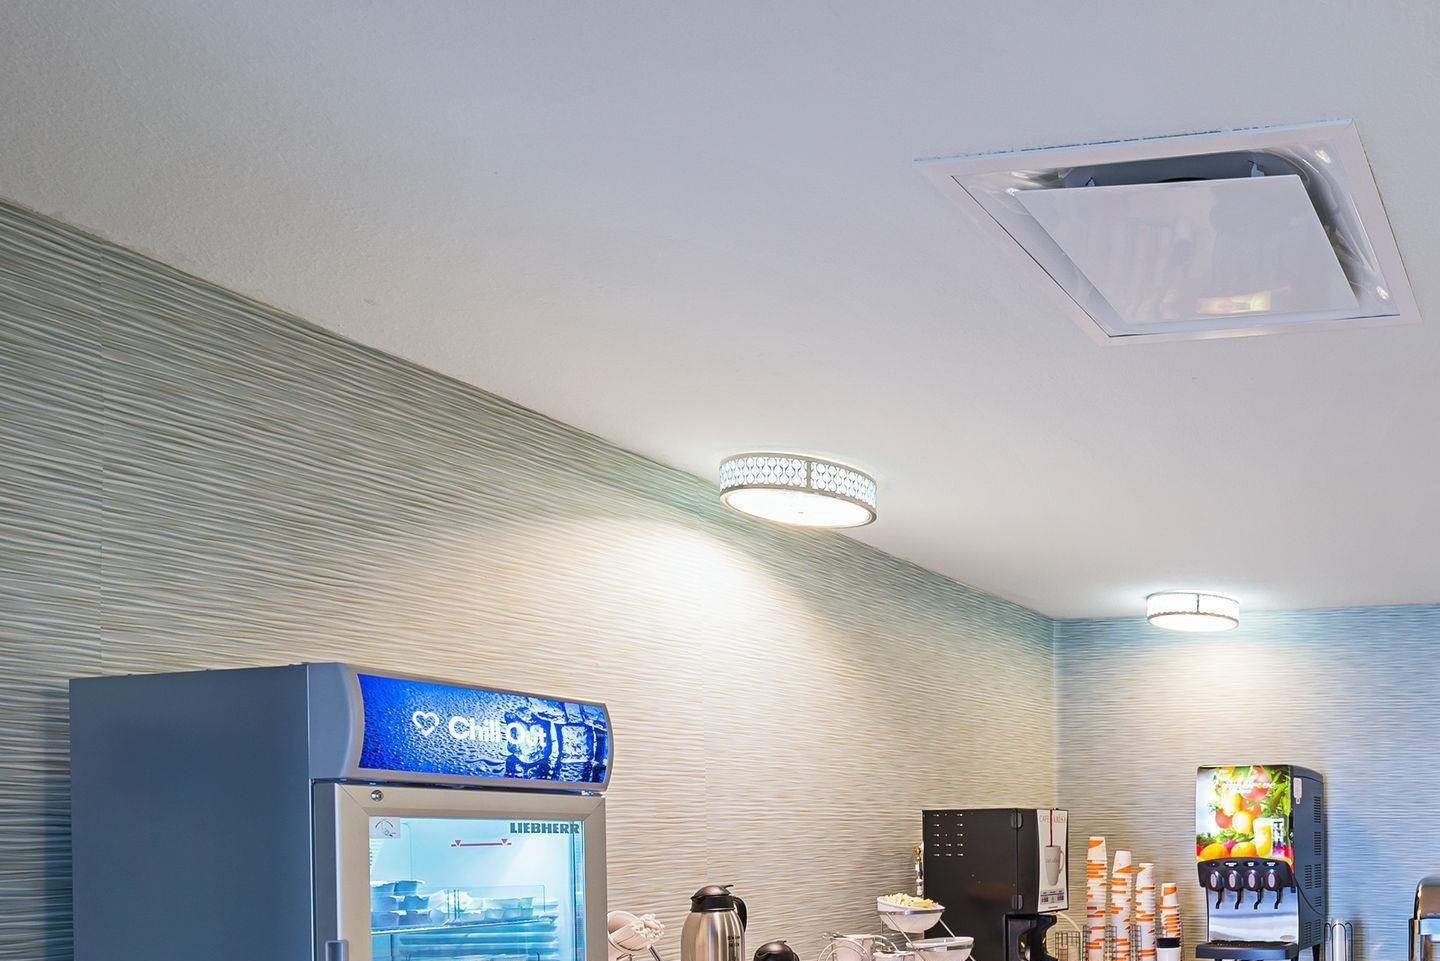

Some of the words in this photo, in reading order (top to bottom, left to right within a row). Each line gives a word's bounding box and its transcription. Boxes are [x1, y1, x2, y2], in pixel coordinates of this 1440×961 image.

[449, 716, 500, 743] Chill
[505, 722, 547, 748] Out
[510, 822, 580, 834] LIEBHERR
